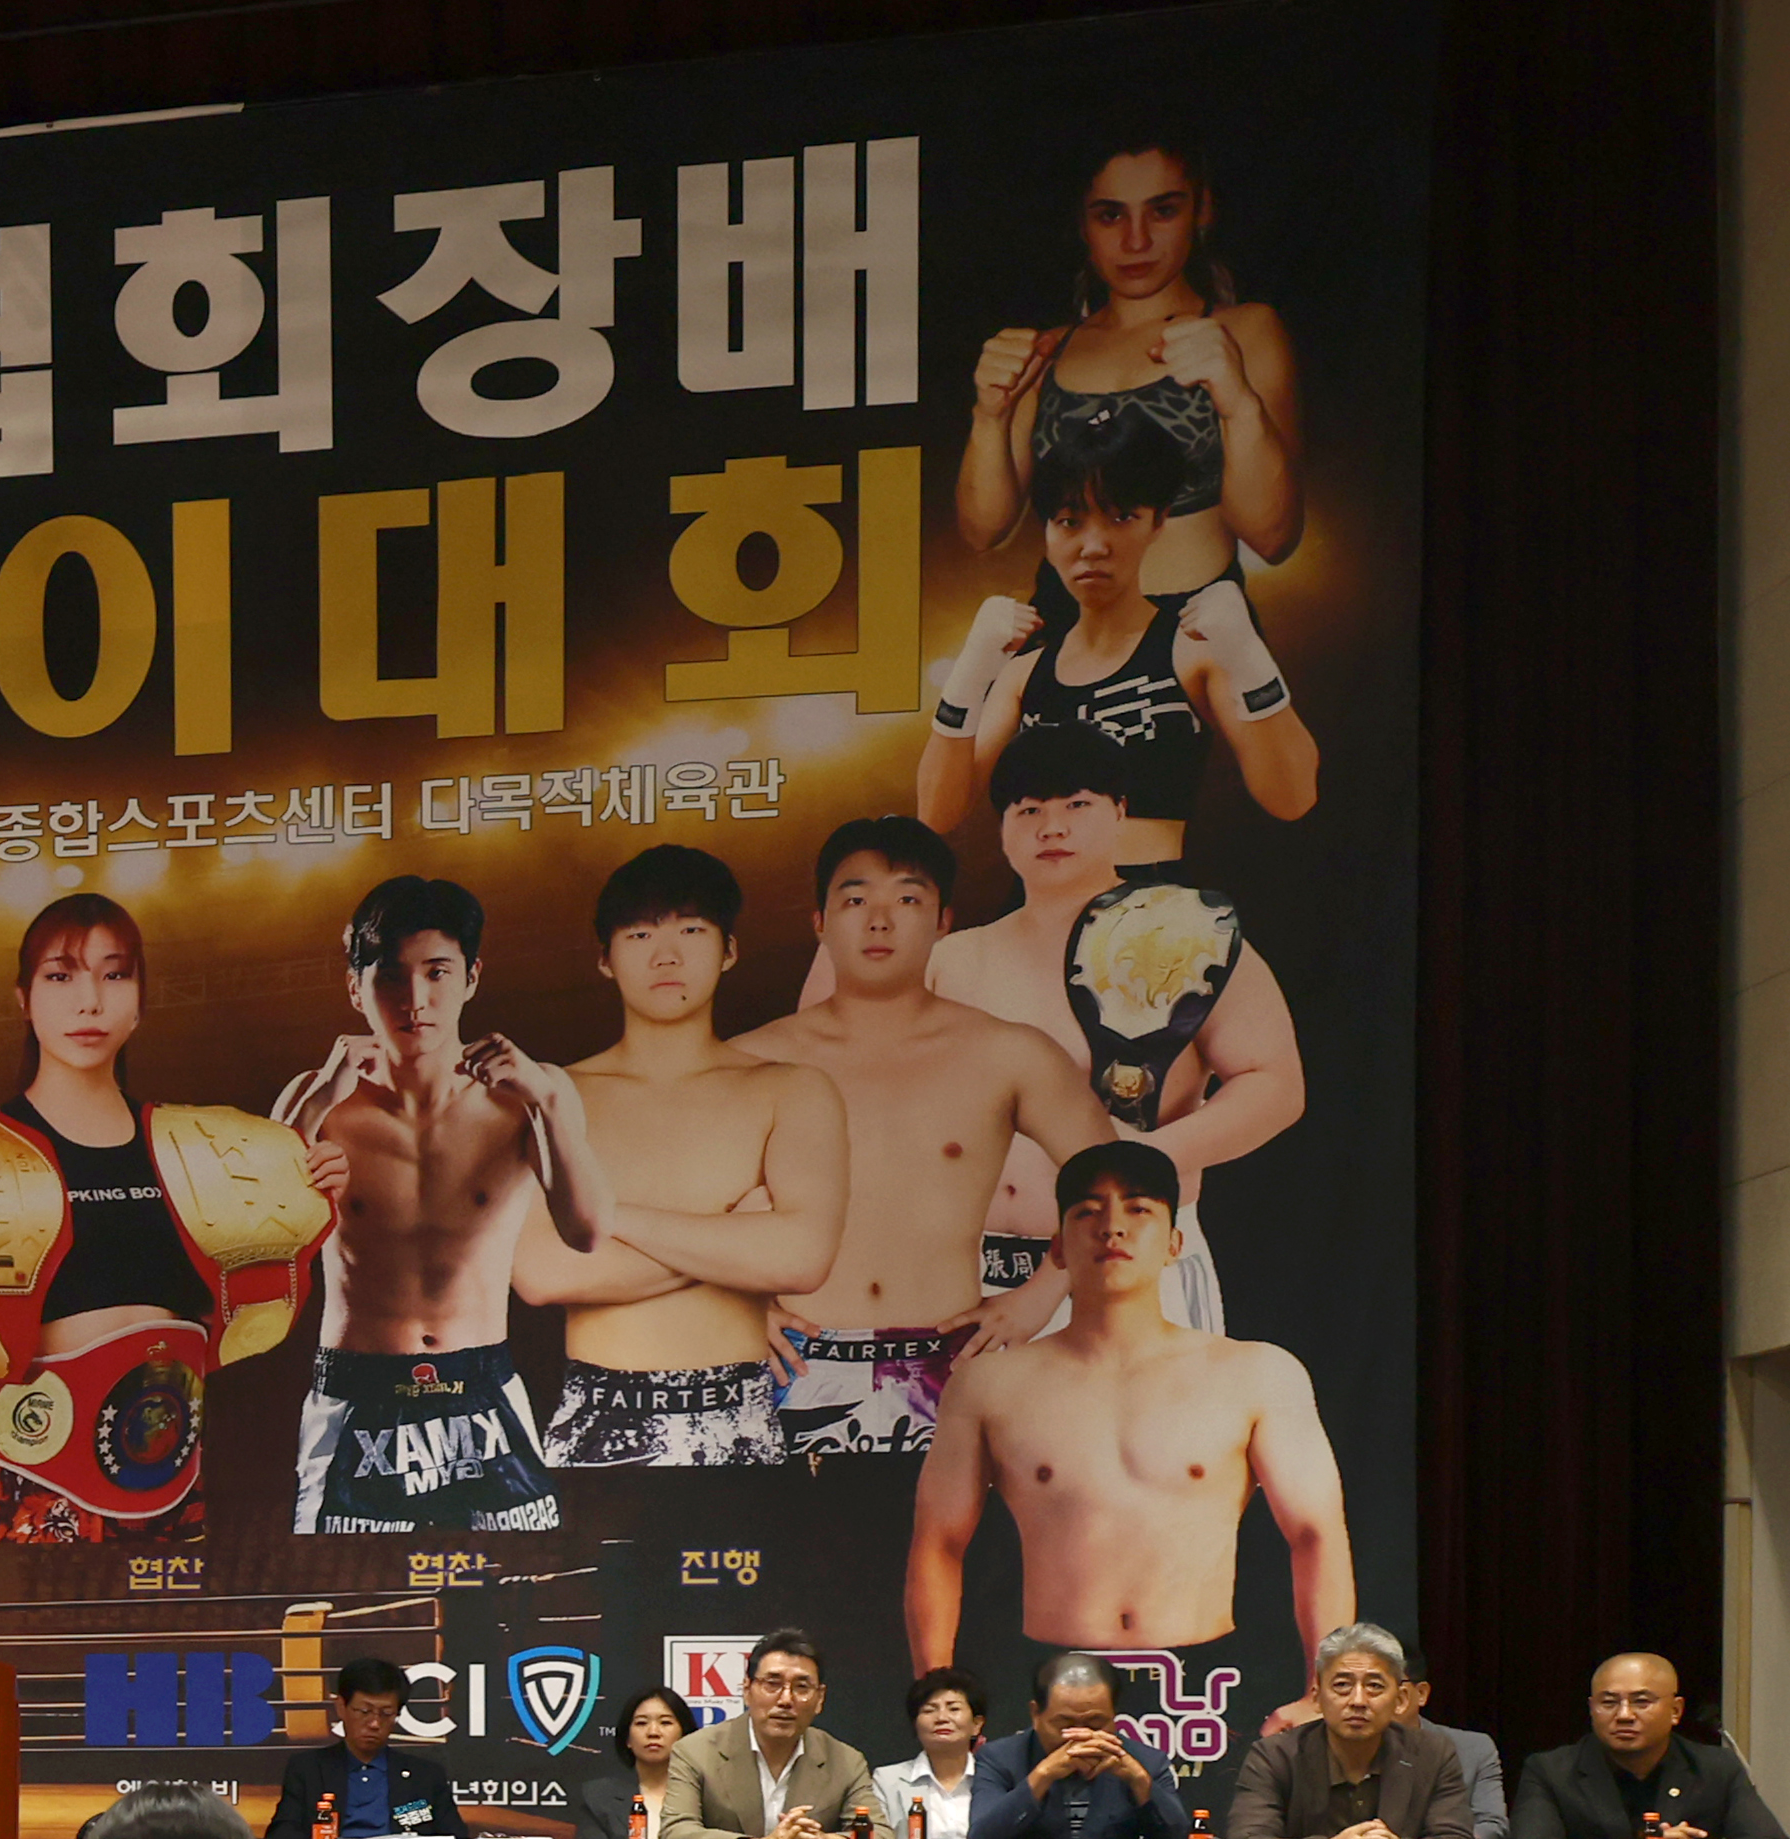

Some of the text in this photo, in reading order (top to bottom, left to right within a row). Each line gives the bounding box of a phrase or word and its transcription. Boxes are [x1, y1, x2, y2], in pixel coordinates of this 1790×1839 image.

[420, 757, 787, 838] 다목적체육관
[984, 1248, 1046, 1280] 張周
[805, 1337, 943, 1360] FAIRTEX
[591, 1385, 739, 1409] FAIRTEX
[128, 1556, 204, 1590] 협찬
[407, 1552, 486, 1588] 협찬
[680, 1549, 761, 1587] 진행
[599, 1726, 615, 1736] TM
[448, 1780, 567, 1806] 년회의소
